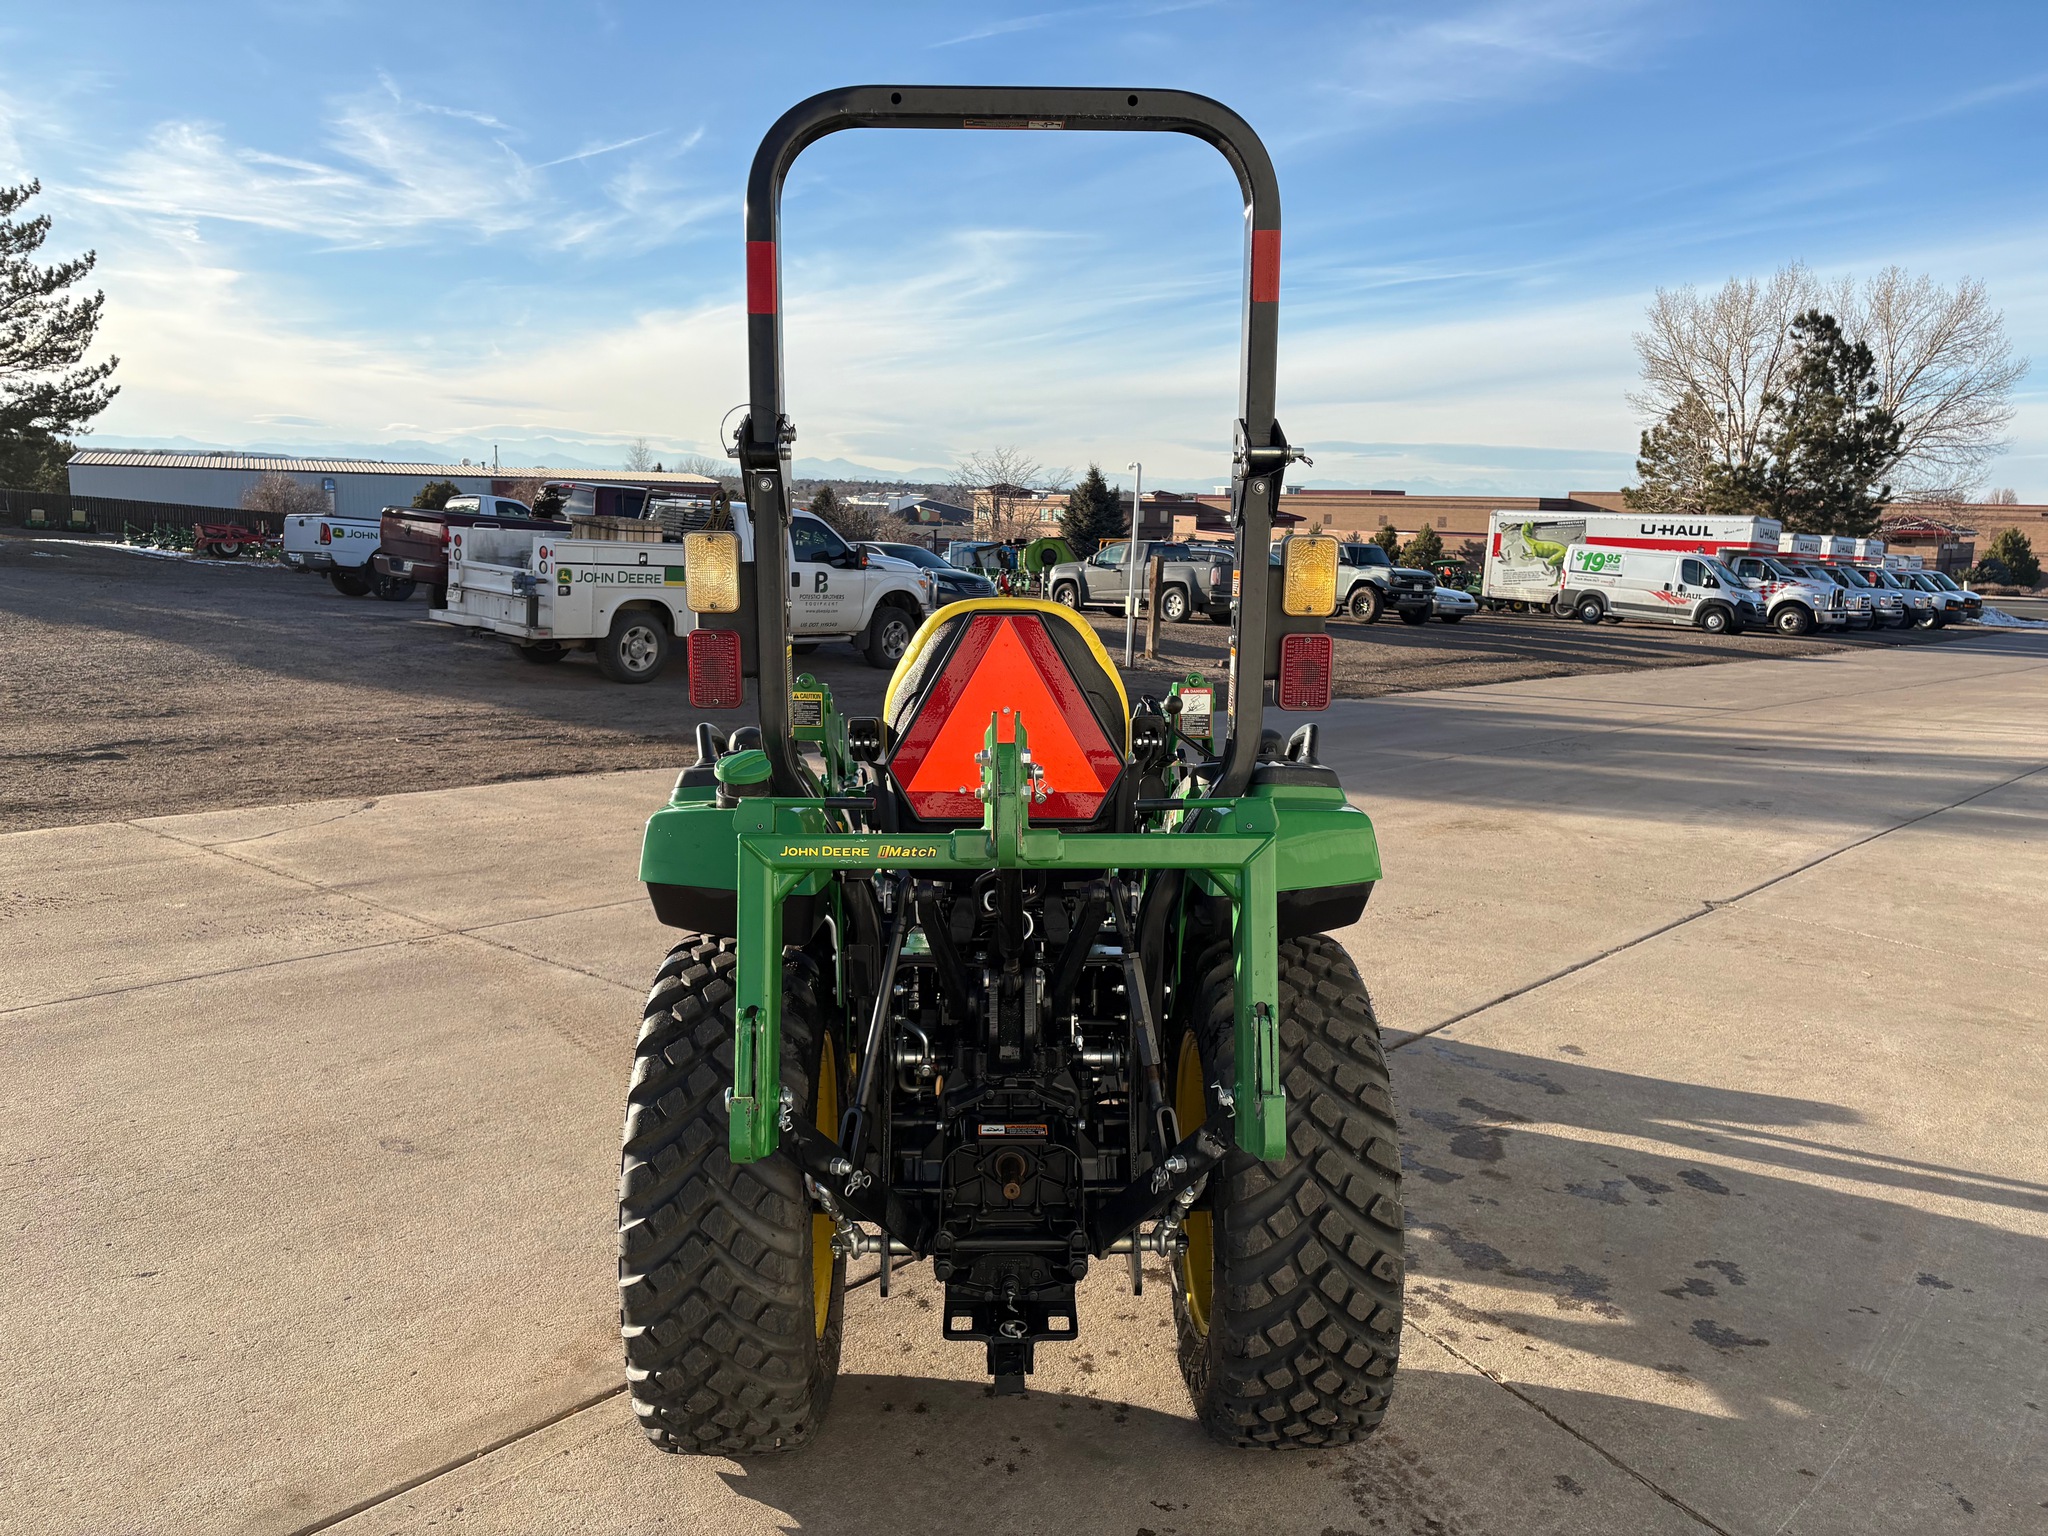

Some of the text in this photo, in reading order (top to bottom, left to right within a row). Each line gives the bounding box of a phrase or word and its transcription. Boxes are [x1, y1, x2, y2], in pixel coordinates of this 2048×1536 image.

[347, 529, 378, 539] JOHN
[1640, 524, 1713, 537] U-HAUL
[1760, 528, 1779, 540] U-HAUL
[575, 570, 662, 584] JOHN DEERE
[1671, 591, 1702, 600] U-HAUL
[780, 844, 937, 859] JOHN DEERE iMatch
